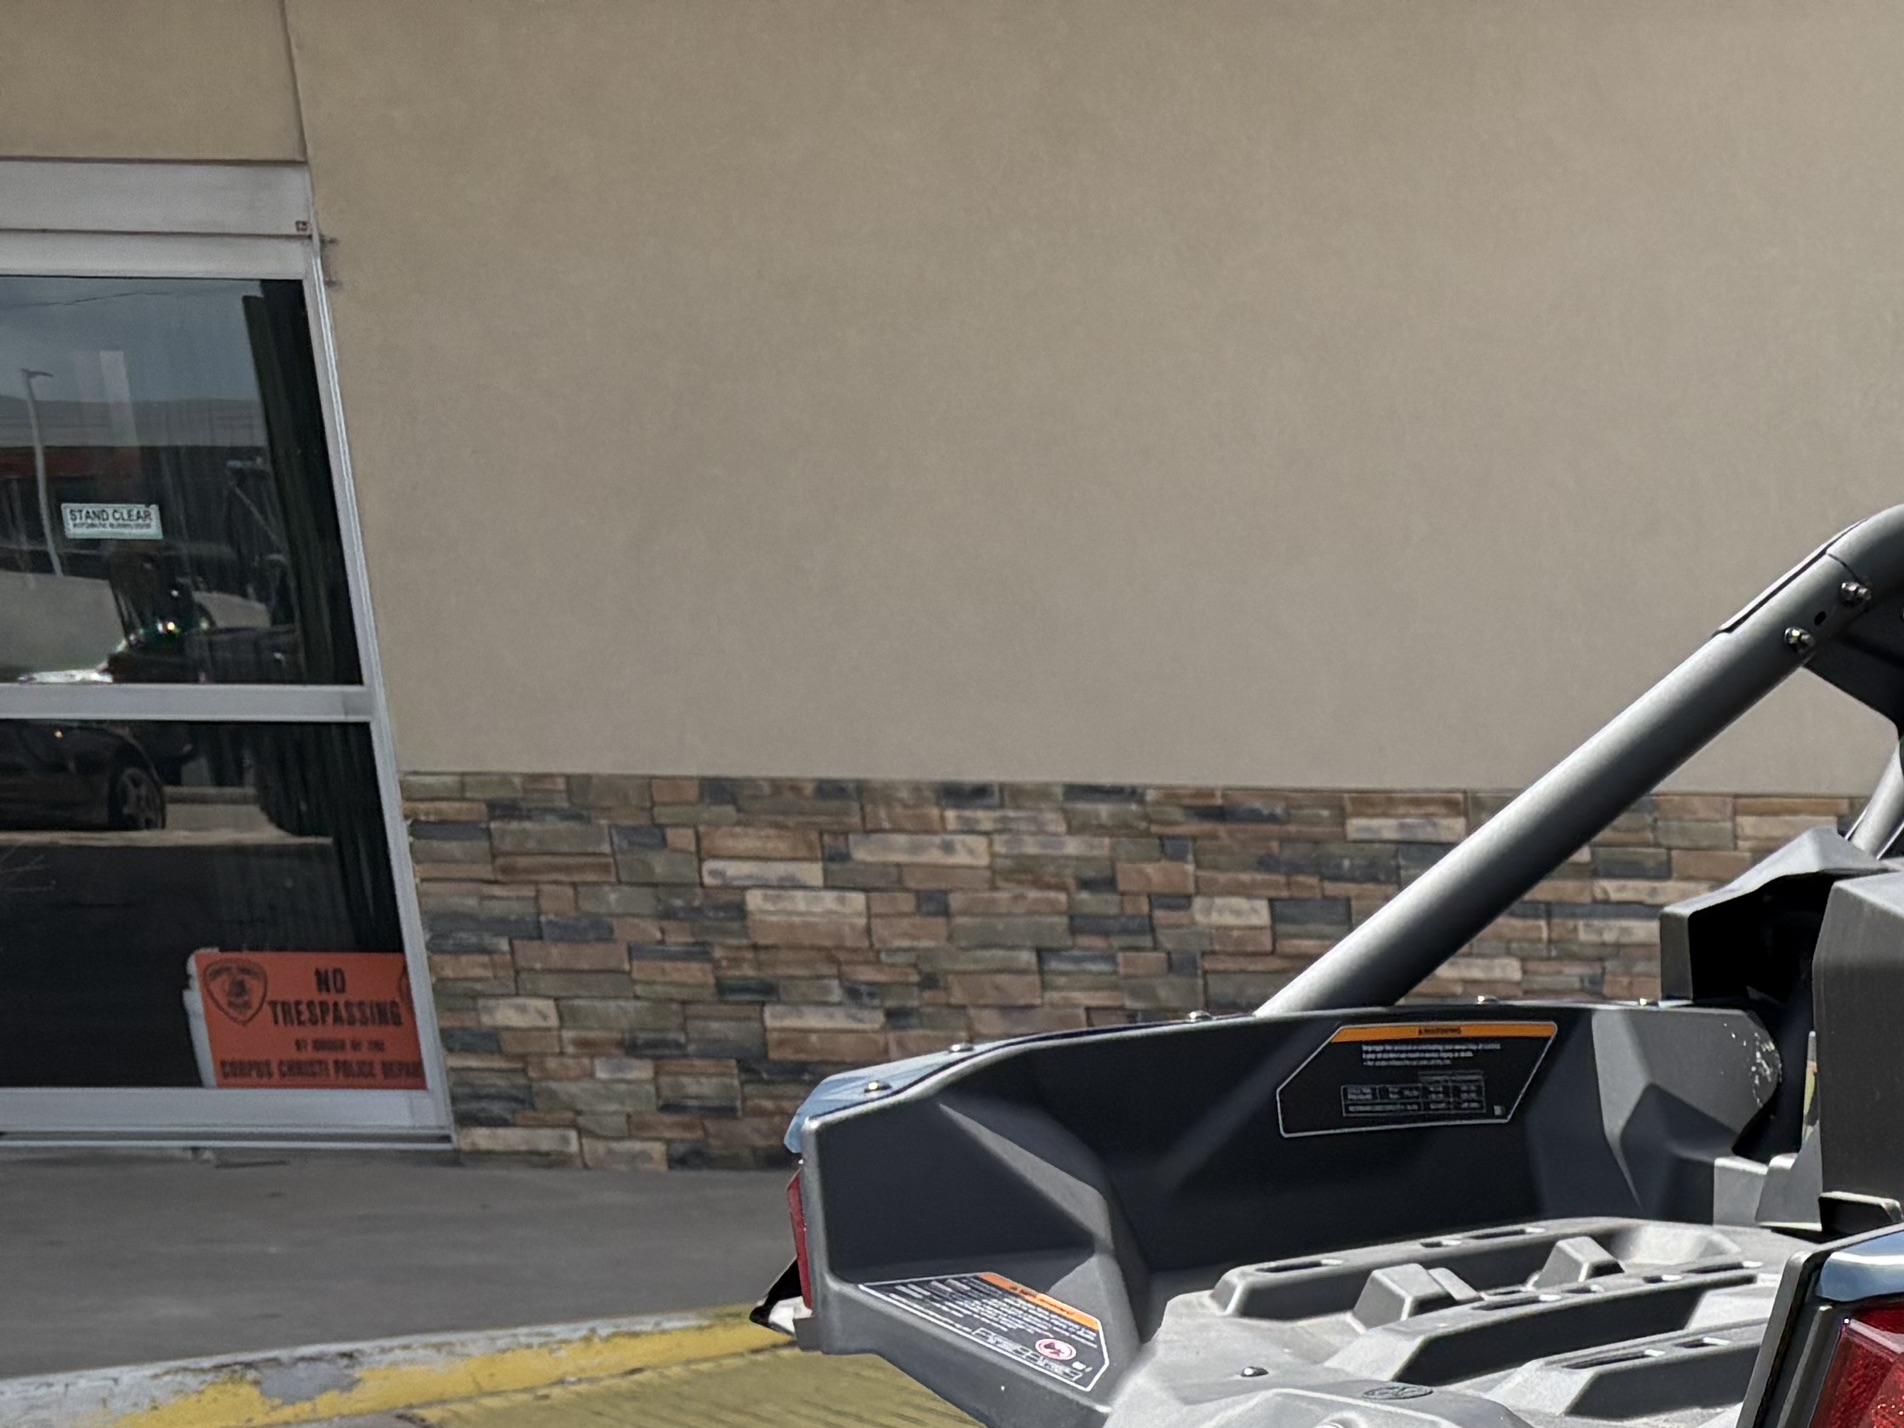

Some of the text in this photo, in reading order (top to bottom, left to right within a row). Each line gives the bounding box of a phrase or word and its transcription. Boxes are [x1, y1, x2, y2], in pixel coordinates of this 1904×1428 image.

[69, 509, 153, 522] STAND CLEAR
[315, 967, 346, 994] NO
[269, 1000, 403, 1027] TRESPASSING
